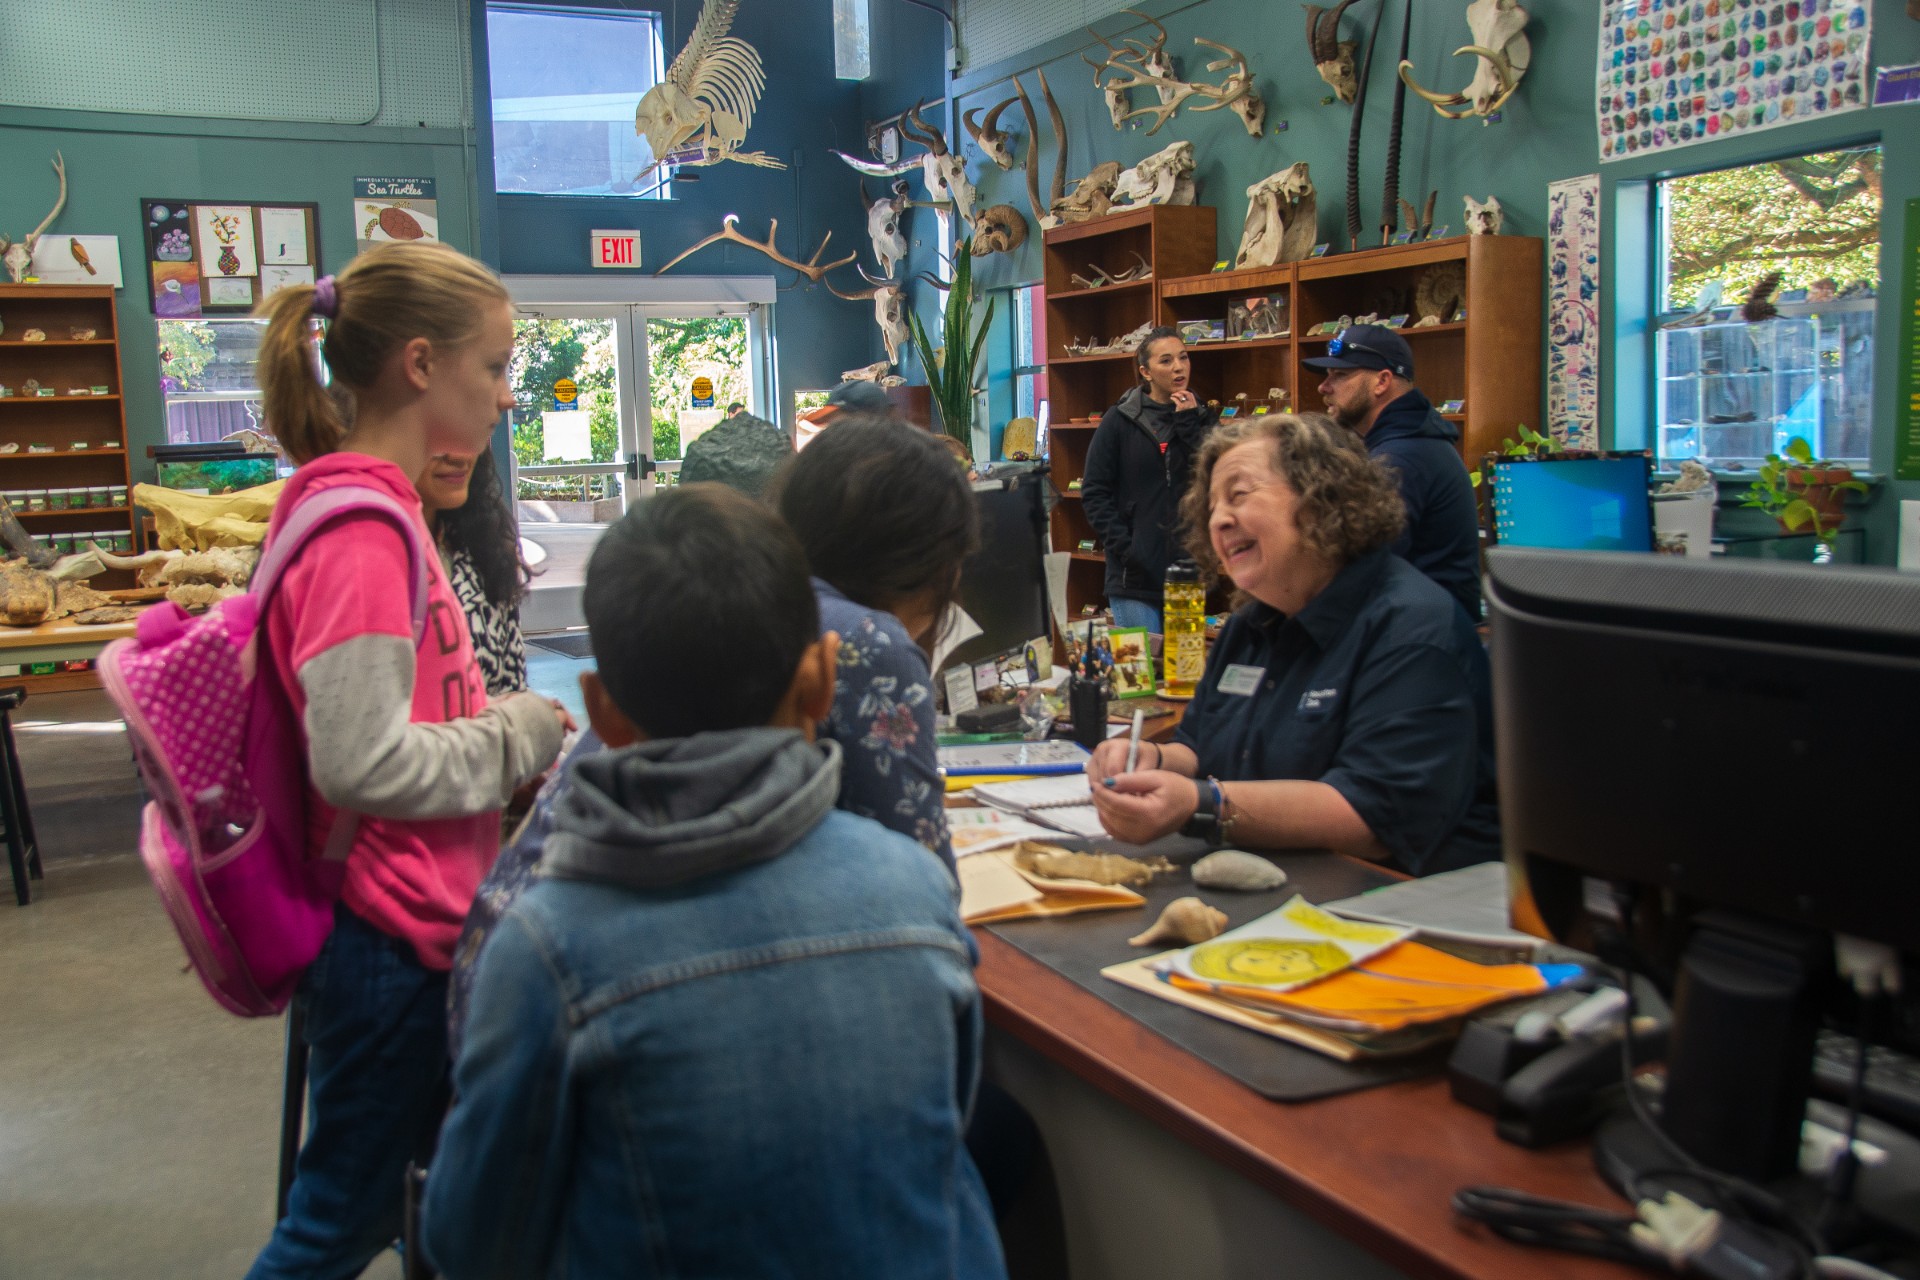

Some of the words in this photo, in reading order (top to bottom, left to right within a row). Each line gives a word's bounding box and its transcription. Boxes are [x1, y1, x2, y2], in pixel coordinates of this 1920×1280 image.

[367, 183, 388, 195] Sea
[388, 183, 423, 196] Turtles
[601, 238, 634, 264] EXIT
